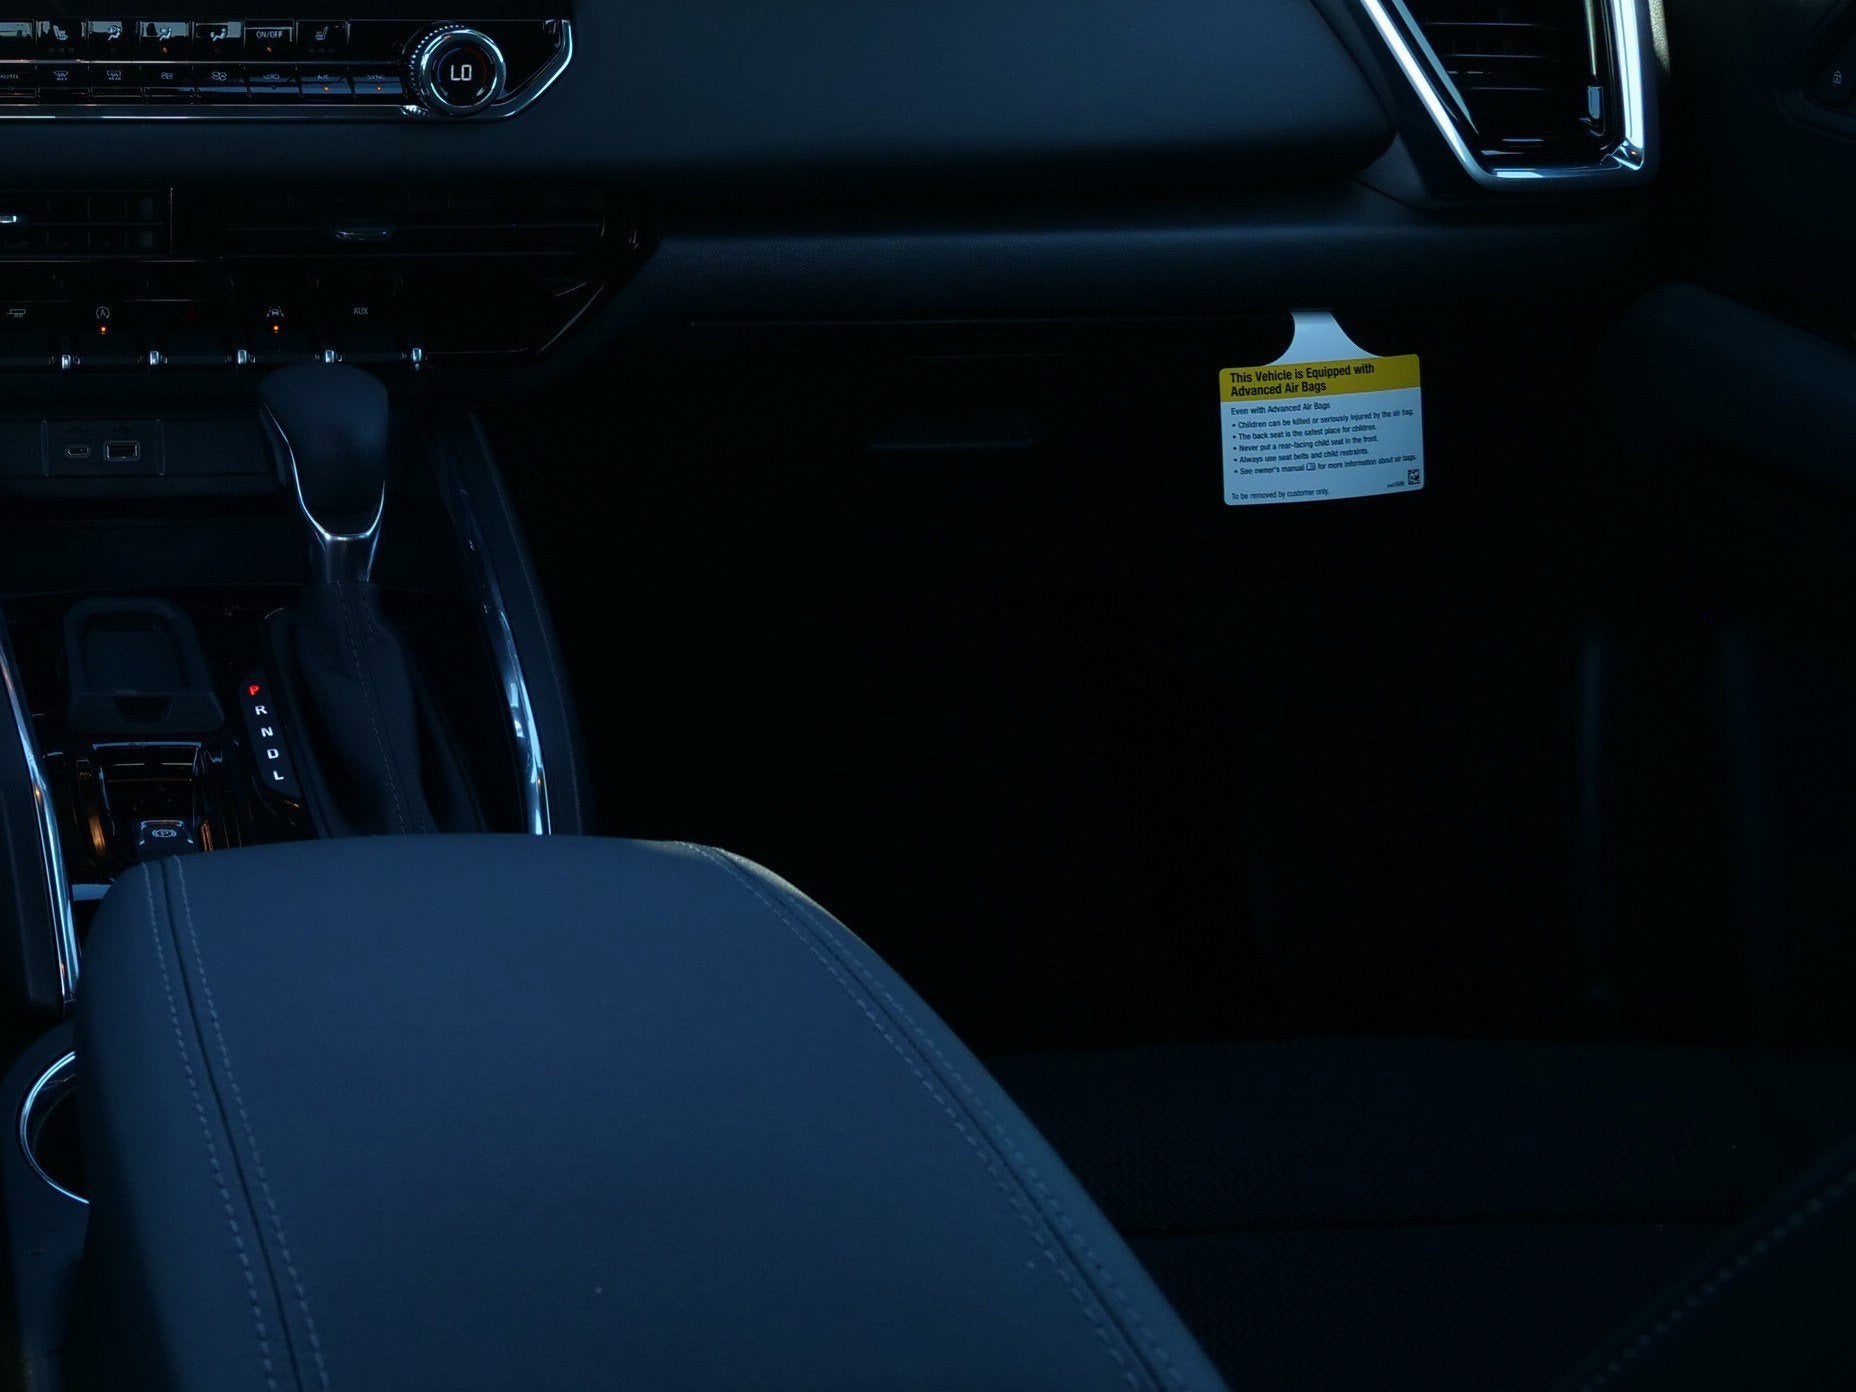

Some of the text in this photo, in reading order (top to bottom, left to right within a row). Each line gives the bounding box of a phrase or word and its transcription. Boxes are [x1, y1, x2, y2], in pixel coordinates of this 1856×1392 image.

[256, 30, 282, 39] ON/OFF
[450, 64, 472, 81] LO
[353, 307, 368, 316] AUX
[1230, 364, 1374, 383] This Vehicle is Equipped with
[1230, 381, 1326, 397] Advanced Air Bags
[1231, 408, 1248, 416] Even
[1250, 406, 1266, 414] with
[1268, 404, 1300, 413] Advanced
[1314, 402, 1330, 411] Bags
[1238, 420, 1266, 428] Children
[1292, 418, 1310, 426] killed
[1320, 414, 1348, 424] seriously
[1350, 412, 1372, 422] injured
[1372, 412, 1380, 420] by
[1382, 410, 1392, 418] the
[1238, 432, 1250, 440] The
[1304, 428, 1322, 436] safest
[1324, 426, 1340, 436] place
[1239, 444, 1258, 452] Never
[1260, 443, 1270, 452] put
[1314, 438, 1330, 446] child
[1352, 436, 1362, 444] the
[1240, 492, 1248, 500] be
[1250, 491, 1276, 499] removed
[1278, 490, 1286, 499] by
[1287, 488, 1314, 498] customer
[250, 686, 260, 696] P
[254, 705, 267, 716] R
[260, 726, 274, 738] N
[267, 748, 279, 759] D
[273, 770, 284, 780] L
